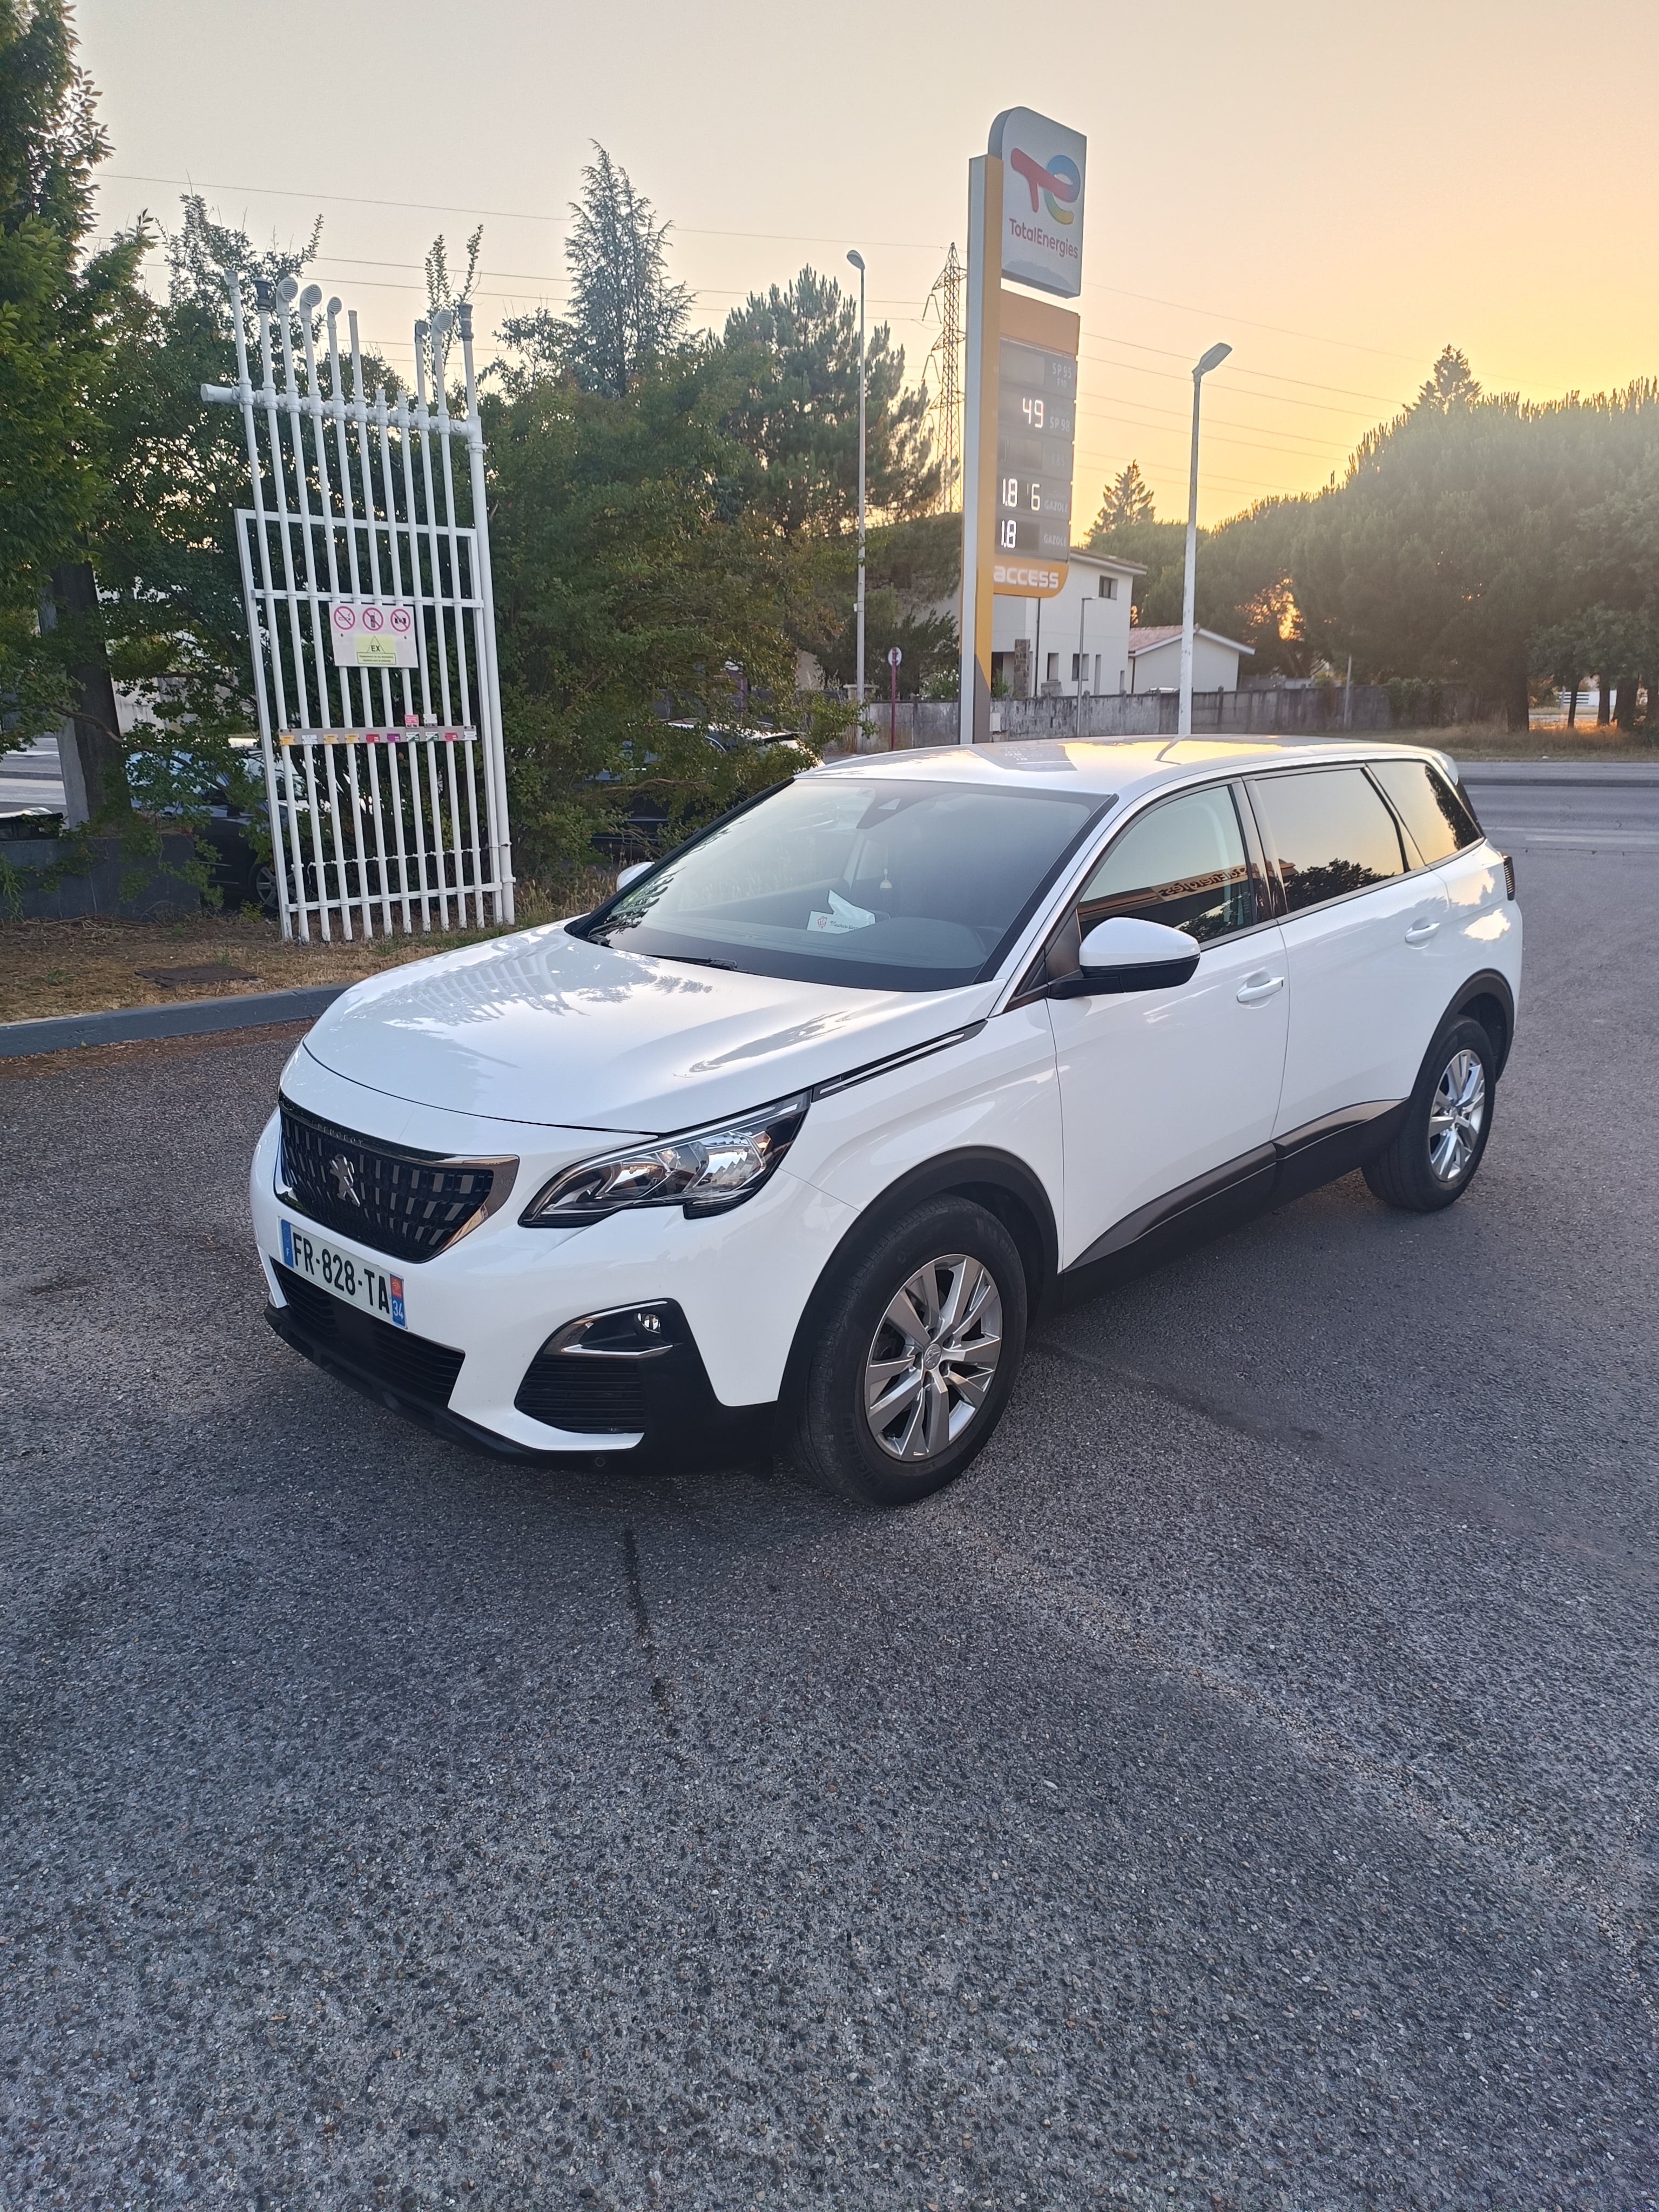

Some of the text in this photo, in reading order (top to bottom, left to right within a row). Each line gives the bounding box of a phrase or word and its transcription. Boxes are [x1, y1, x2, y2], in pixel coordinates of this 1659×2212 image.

[1009, 218, 1078, 259] TotalEnergies
[1052, 363, 1072, 379] SP 95
[1050, 416, 1070, 432] SP 98
[1044, 500, 1068, 512] GAZOLE
[1043, 534, 1067, 547] GAZOLE
[994, 565, 1059, 589] access
[318, 1123, 363, 1145] PEUGEOT
[286, 1248, 289, 1257] F
[293, 1232, 390, 1314] FR-828-TA
[393, 1300, 404, 1319] 34
